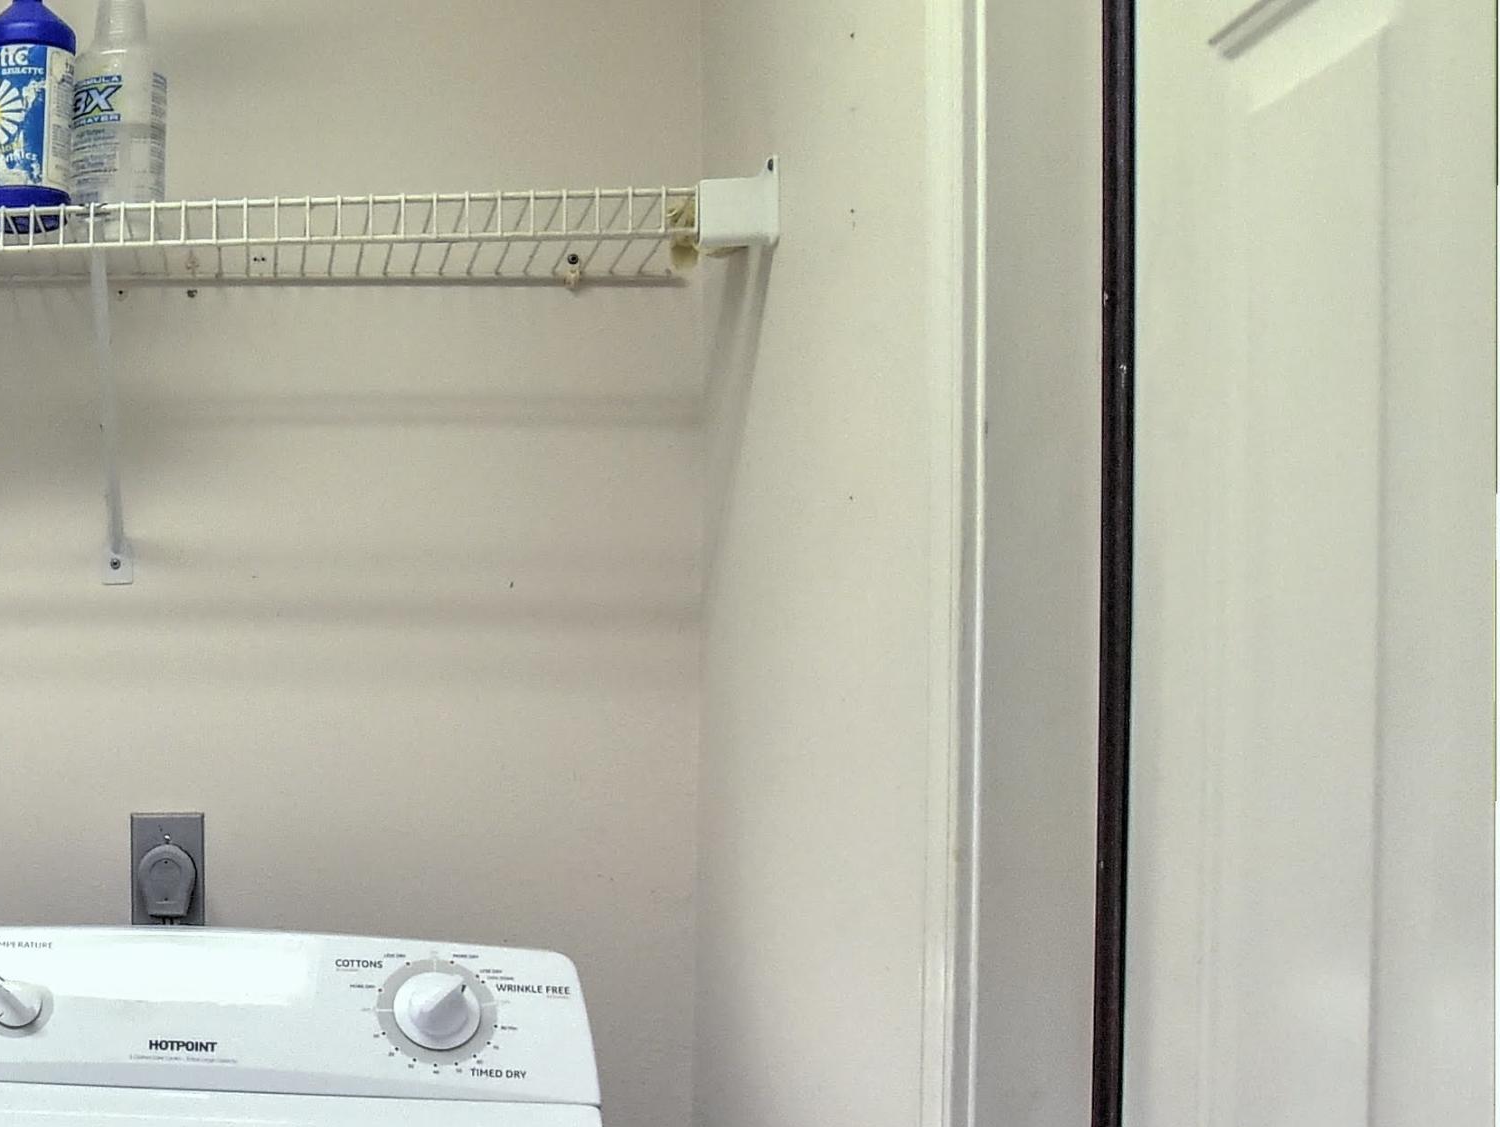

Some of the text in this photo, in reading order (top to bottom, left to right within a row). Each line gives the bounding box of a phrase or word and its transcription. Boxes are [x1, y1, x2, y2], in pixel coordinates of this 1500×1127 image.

[335, 959, 383, 969] COTTONS
[496, 983, 571, 995] WRINKLE FREE
[148, 1040, 218, 1052] HOTPOINT
[470, 1067, 527, 1079] TIMED DRY
